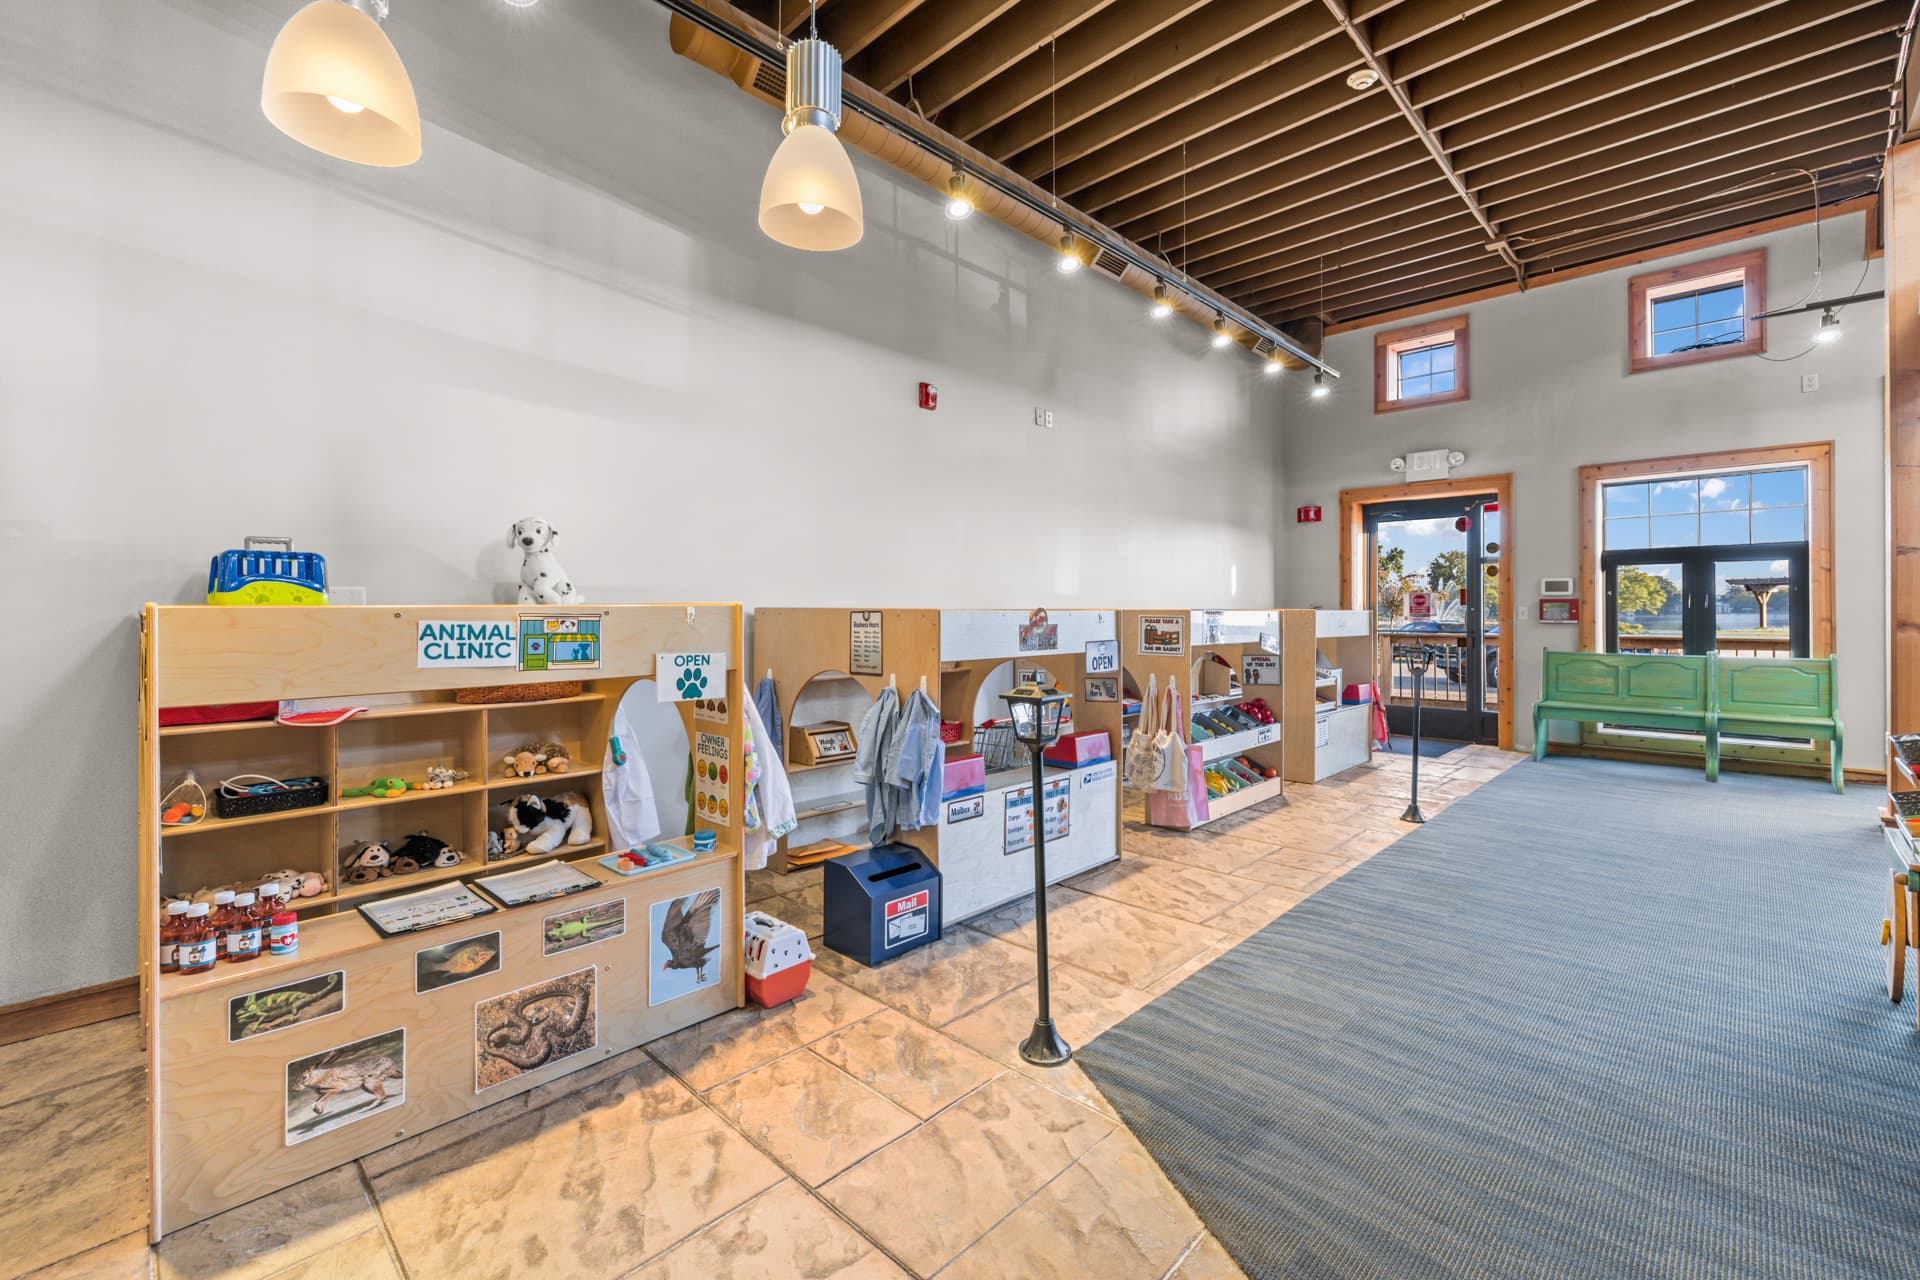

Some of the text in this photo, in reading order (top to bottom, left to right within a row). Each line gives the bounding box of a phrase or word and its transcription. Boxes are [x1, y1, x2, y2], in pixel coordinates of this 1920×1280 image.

[419, 623, 516, 641] ANIMAL
[423, 642, 512, 660] CLINIC
[674, 654, 711, 667] OPEN
[1092, 655, 1113, 671] OPEN
[1090, 682, 1101, 691] Pay
[701, 733, 725, 748] OWNER
[820, 737, 836, 746] Weigh
[823, 744, 836, 752] Here
[697, 743, 728, 760] FEELINGS
[951, 806, 970, 817] Mailbox
[897, 897, 917, 912] Mail
